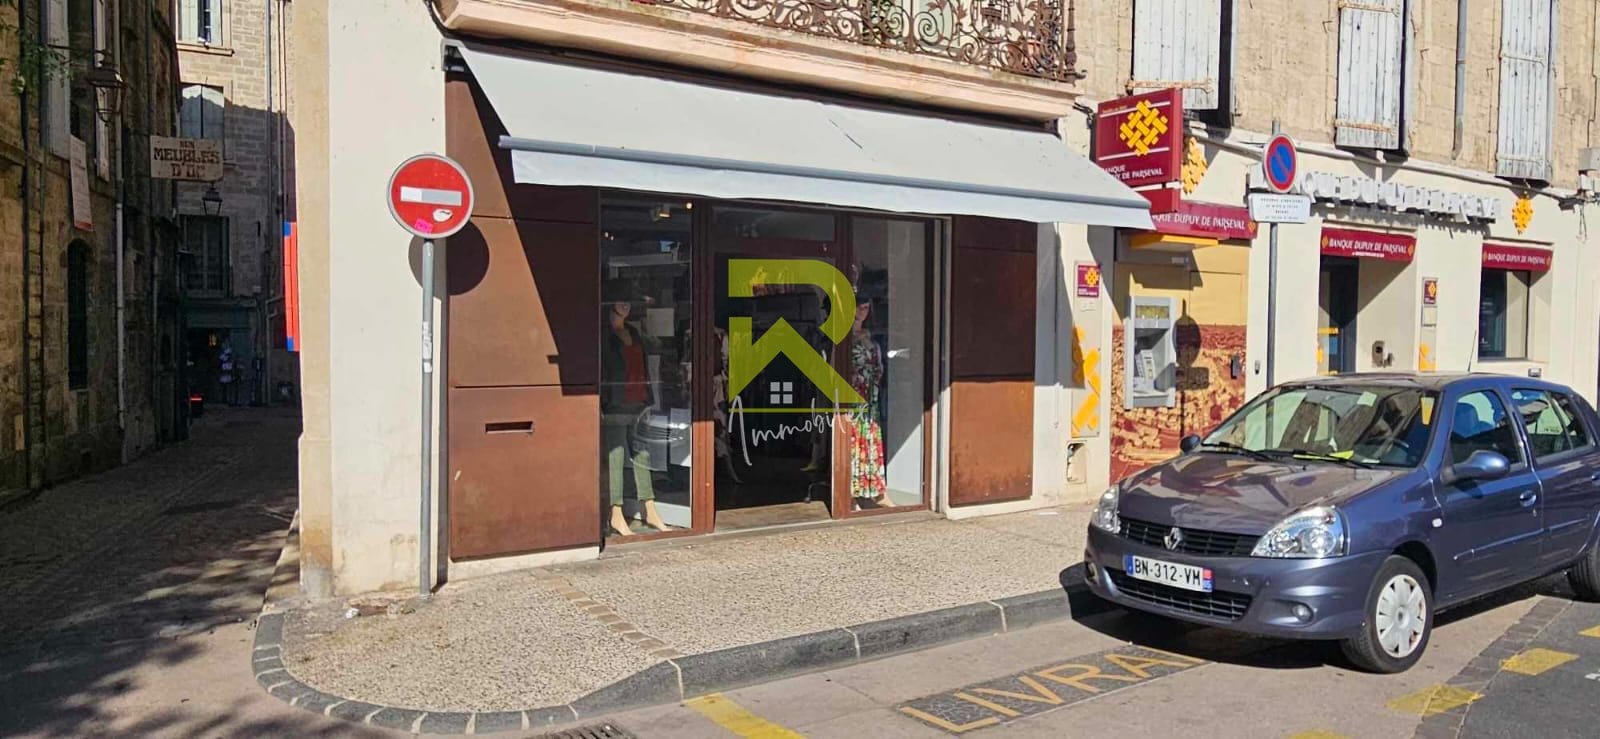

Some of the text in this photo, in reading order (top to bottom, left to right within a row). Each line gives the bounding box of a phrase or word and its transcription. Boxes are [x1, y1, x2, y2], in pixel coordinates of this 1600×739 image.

[154, 147, 220, 164] MEUBLES
[1174, 212, 1200, 225] DUPUY
[1201, 215, 1211, 226] DE
[1213, 217, 1246, 231] PARSEVAL
[1328, 238, 1353, 250] BANQUE
[1354, 240, 1374, 252] DUPUY
[1374, 242, 1382, 252] DE
[1383, 243, 1407, 255] PARSEVAL
